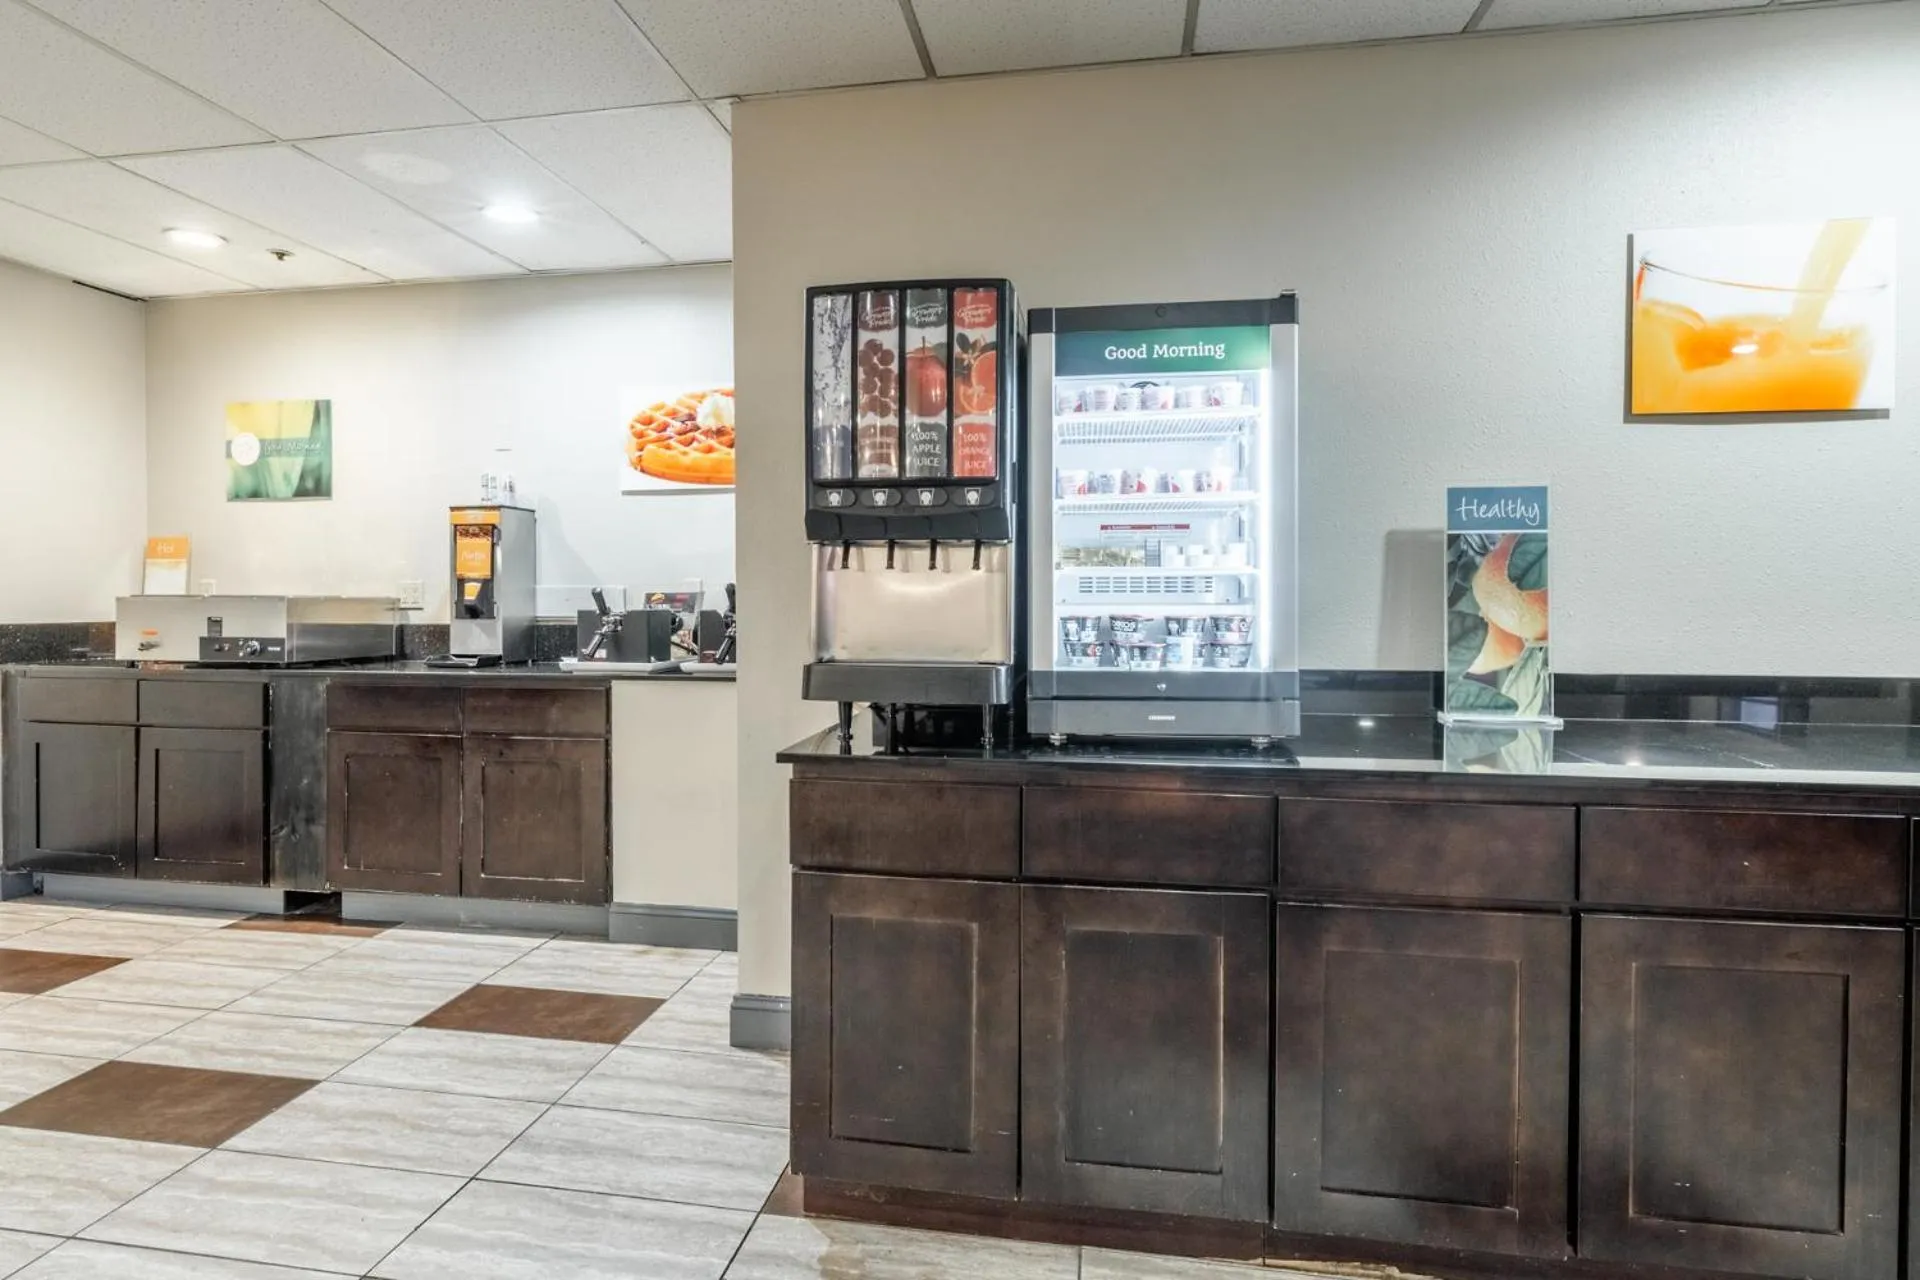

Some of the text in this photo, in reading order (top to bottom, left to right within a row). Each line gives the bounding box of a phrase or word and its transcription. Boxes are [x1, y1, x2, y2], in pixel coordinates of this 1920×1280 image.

[1104, 341, 1225, 360] Good Morning
[911, 431, 938, 441] 100%
[962, 432, 986, 442] 100%
[912, 443, 941, 454] APPLE
[1454, 495, 1540, 526] Healthy
